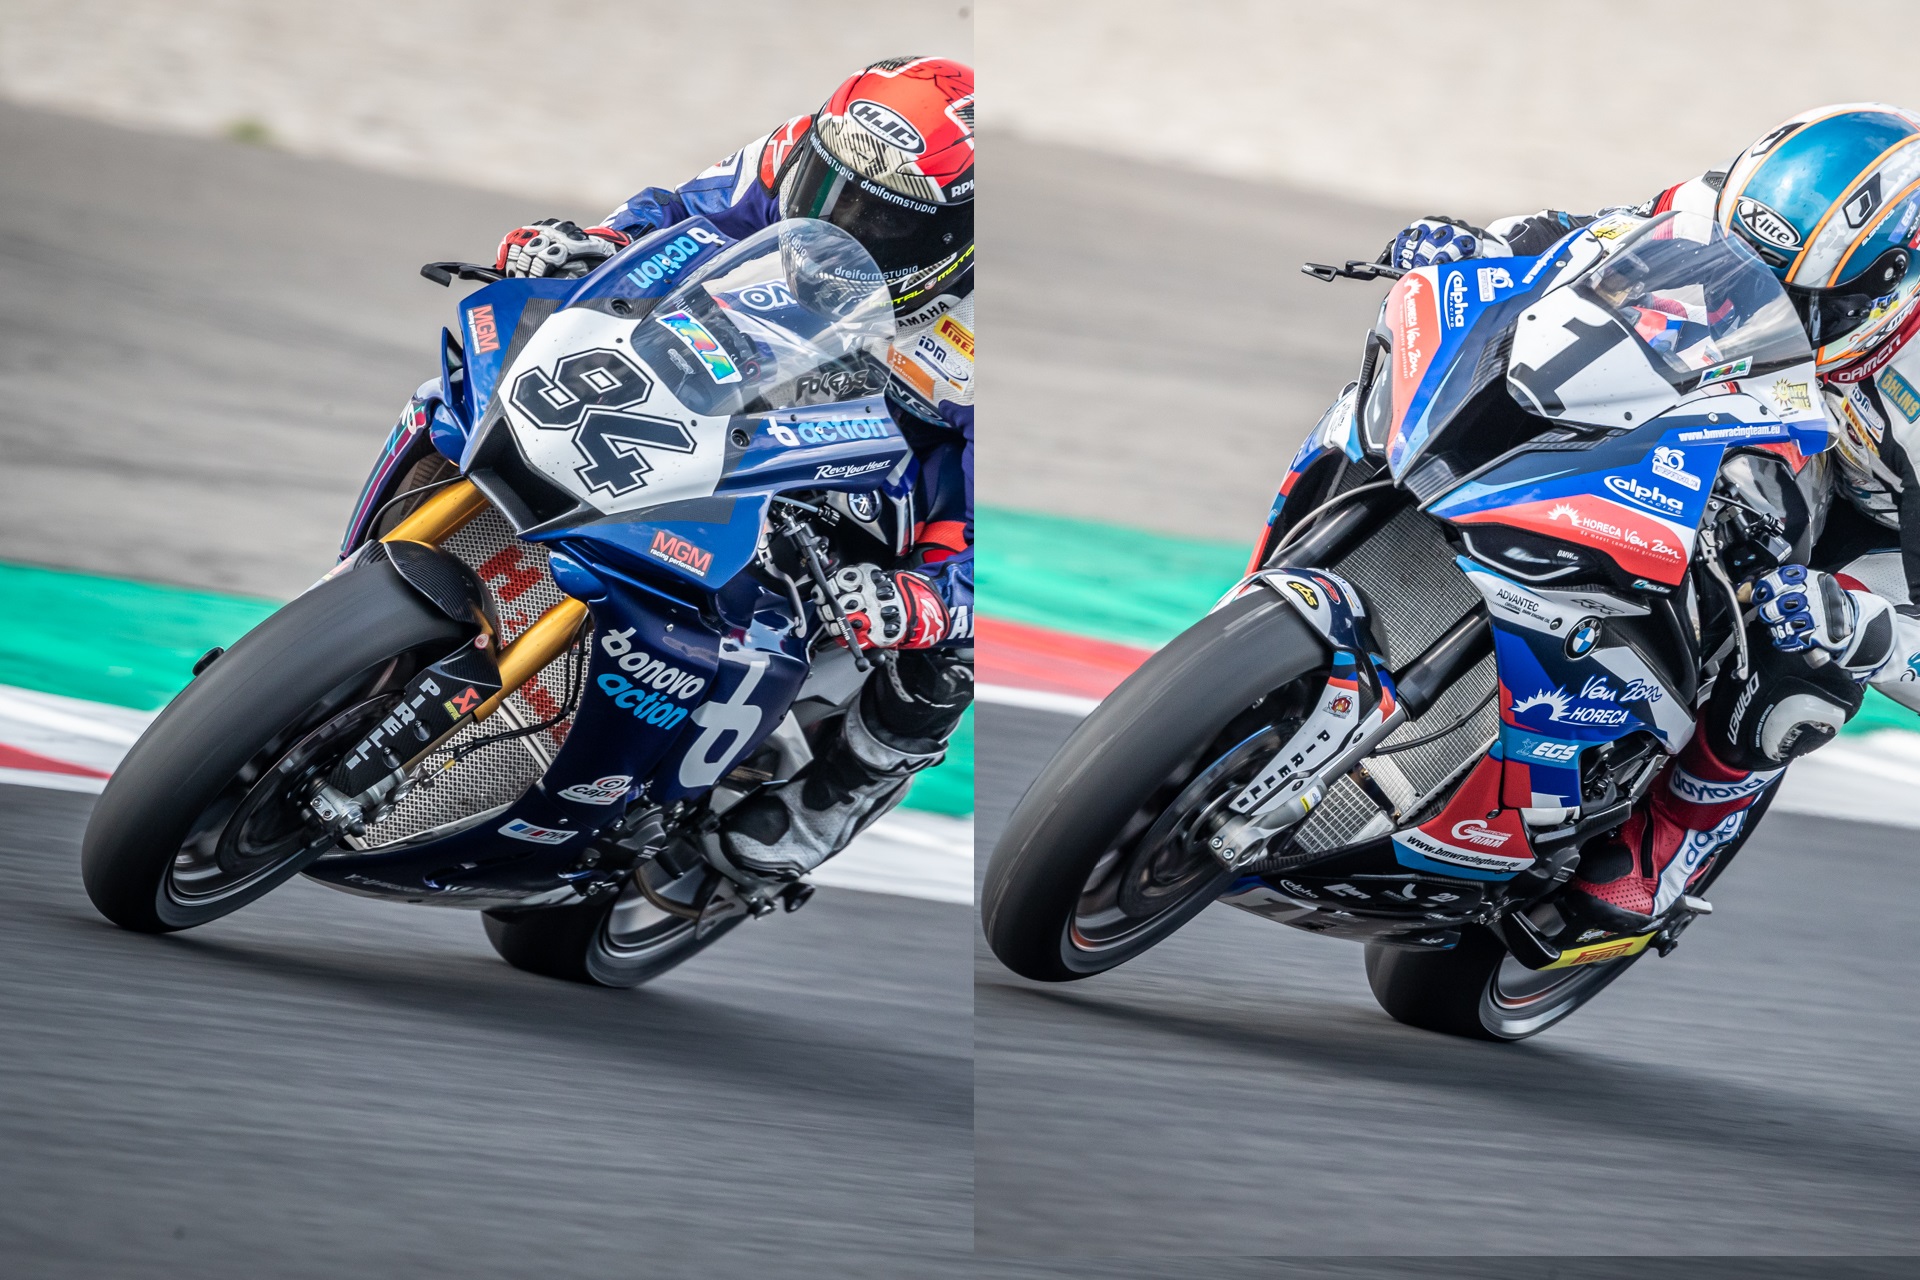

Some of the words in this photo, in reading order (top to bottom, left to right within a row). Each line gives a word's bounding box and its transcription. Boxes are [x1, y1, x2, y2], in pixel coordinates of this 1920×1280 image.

[853, 105, 919, 147] HJC
[860, 178, 938, 215] dreiformSTUDIO
[1739, 202, 1791, 245] X-lite
[626, 236, 700, 289] action
[834, 265, 919, 281] dreiformSTUDIO
[897, 300, 951, 328] AMAHA
[1450, 275, 1469, 328] alpha
[473, 305, 499, 353] MGM
[1512, 314, 1628, 417] 1
[511, 347, 698, 498] 94
[798, 415, 889, 444] action
[1678, 425, 1780, 441] www.bmwracingteam.eu
[1613, 478, 1684, 511] alpha
[1640, 497, 1682, 515] RACING
[652, 531, 712, 572] MGM
[1582, 518, 1622, 538] HORECA
[1624, 528, 1648, 549] Van
[1651, 540, 1682, 559] Zon
[650, 548, 669, 562] racing
[668, 557, 705, 577] performance
[1288, 582, 1318, 606] sbs
[1496, 588, 1540, 612] ADVANTEC
[601, 626, 706, 700] bonovo
[597, 673, 689, 731] action
[1579, 675, 1617, 702] Van
[1619, 679, 1663, 702] Zon
[345, 677, 441, 771] PIRELLI
[1568, 706, 1630, 725] HORECA
[1532, 742, 1580, 760] EGS
[1236, 729, 1331, 809] PIRELLI
[1672, 769, 1766, 801] daytona
[1406, 835, 1521, 868] www.bmwracingteam.eu
[1569, 942, 1634, 965] PIRELLI
